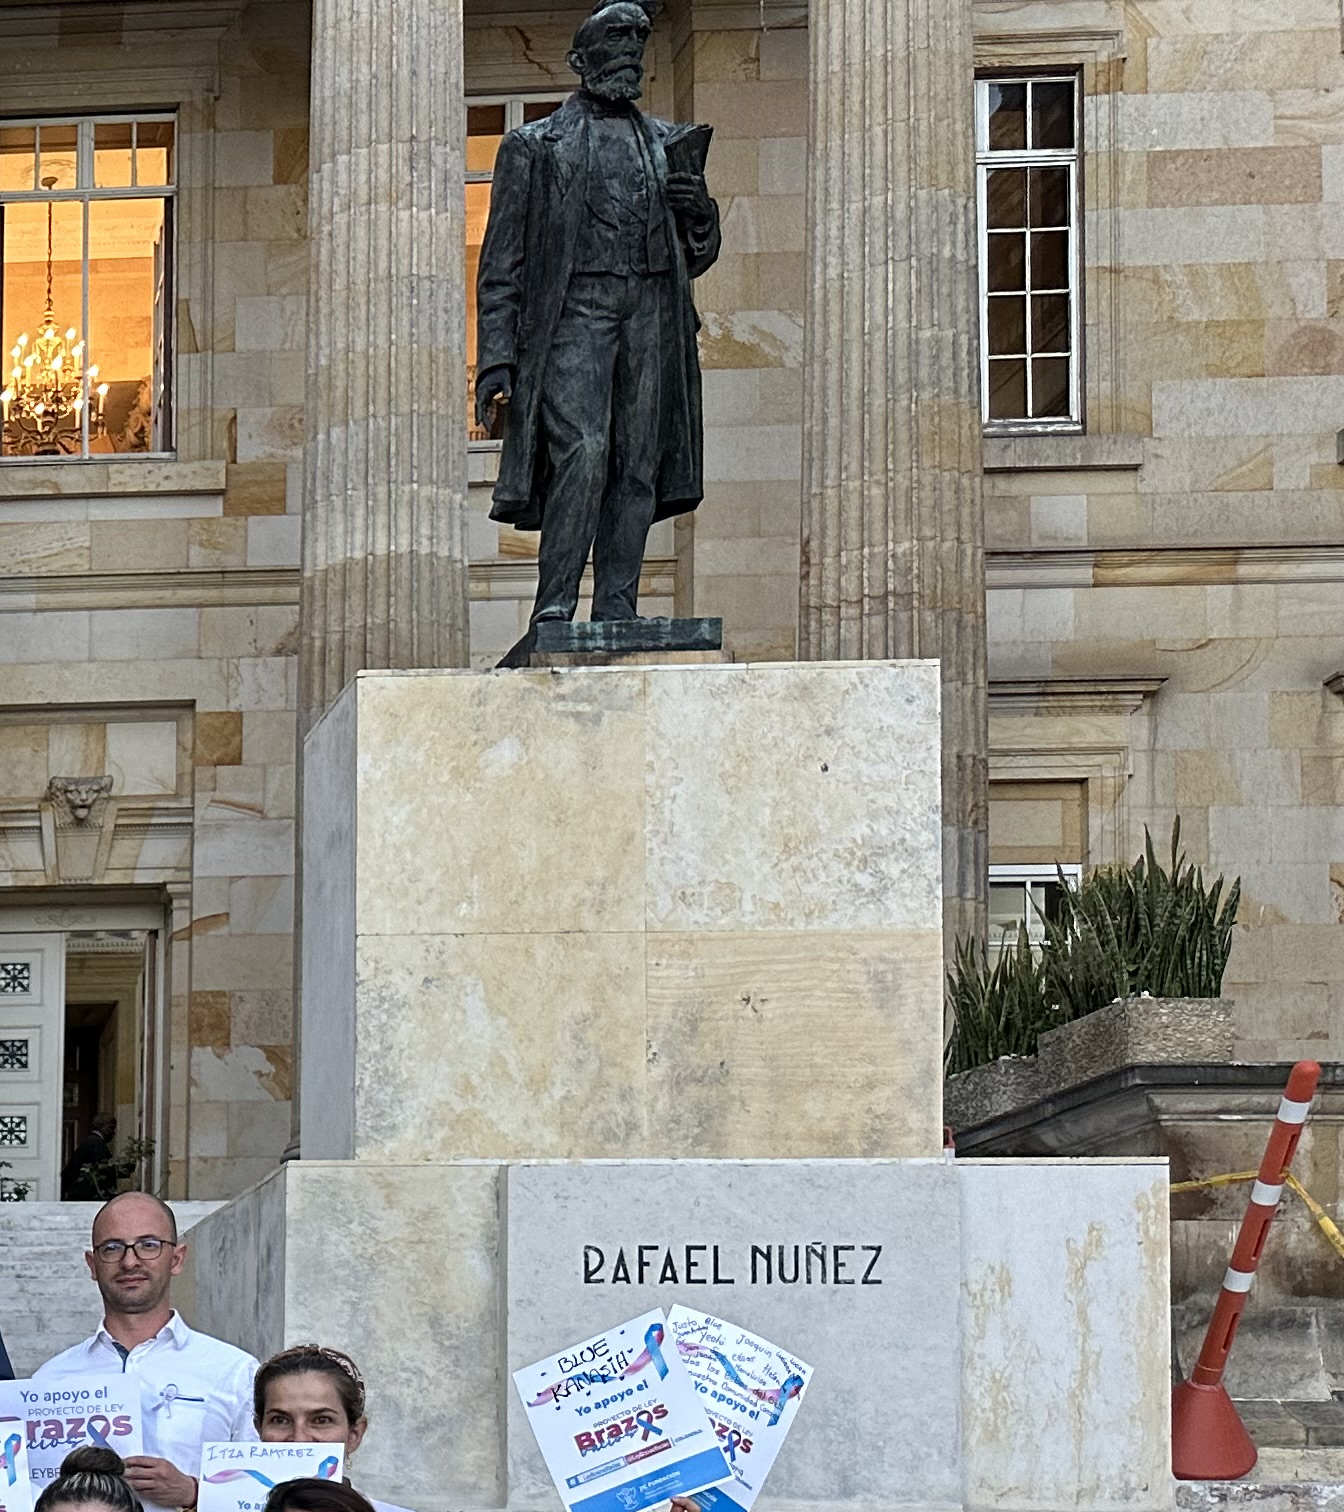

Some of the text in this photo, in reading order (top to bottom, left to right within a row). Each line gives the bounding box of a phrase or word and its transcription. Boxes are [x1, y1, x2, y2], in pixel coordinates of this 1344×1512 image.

[583, 1241, 883, 1286] RAFAEL NUÑEZ
[557, 1338, 610, 1374] BLUE
[20, 1386, 108, 1403] Yo apoyo el
[28, 1404, 124, 1416] PROYECTO DE LEY
[574, 1379, 649, 1417] Yo apoyo el
[694, 1380, 760, 1420] Yo apoyo el
[26, 1415, 133, 1441] razos
[574, 1403, 669, 1452] Brazos
[237, 1501, 251, 1510] Yo
